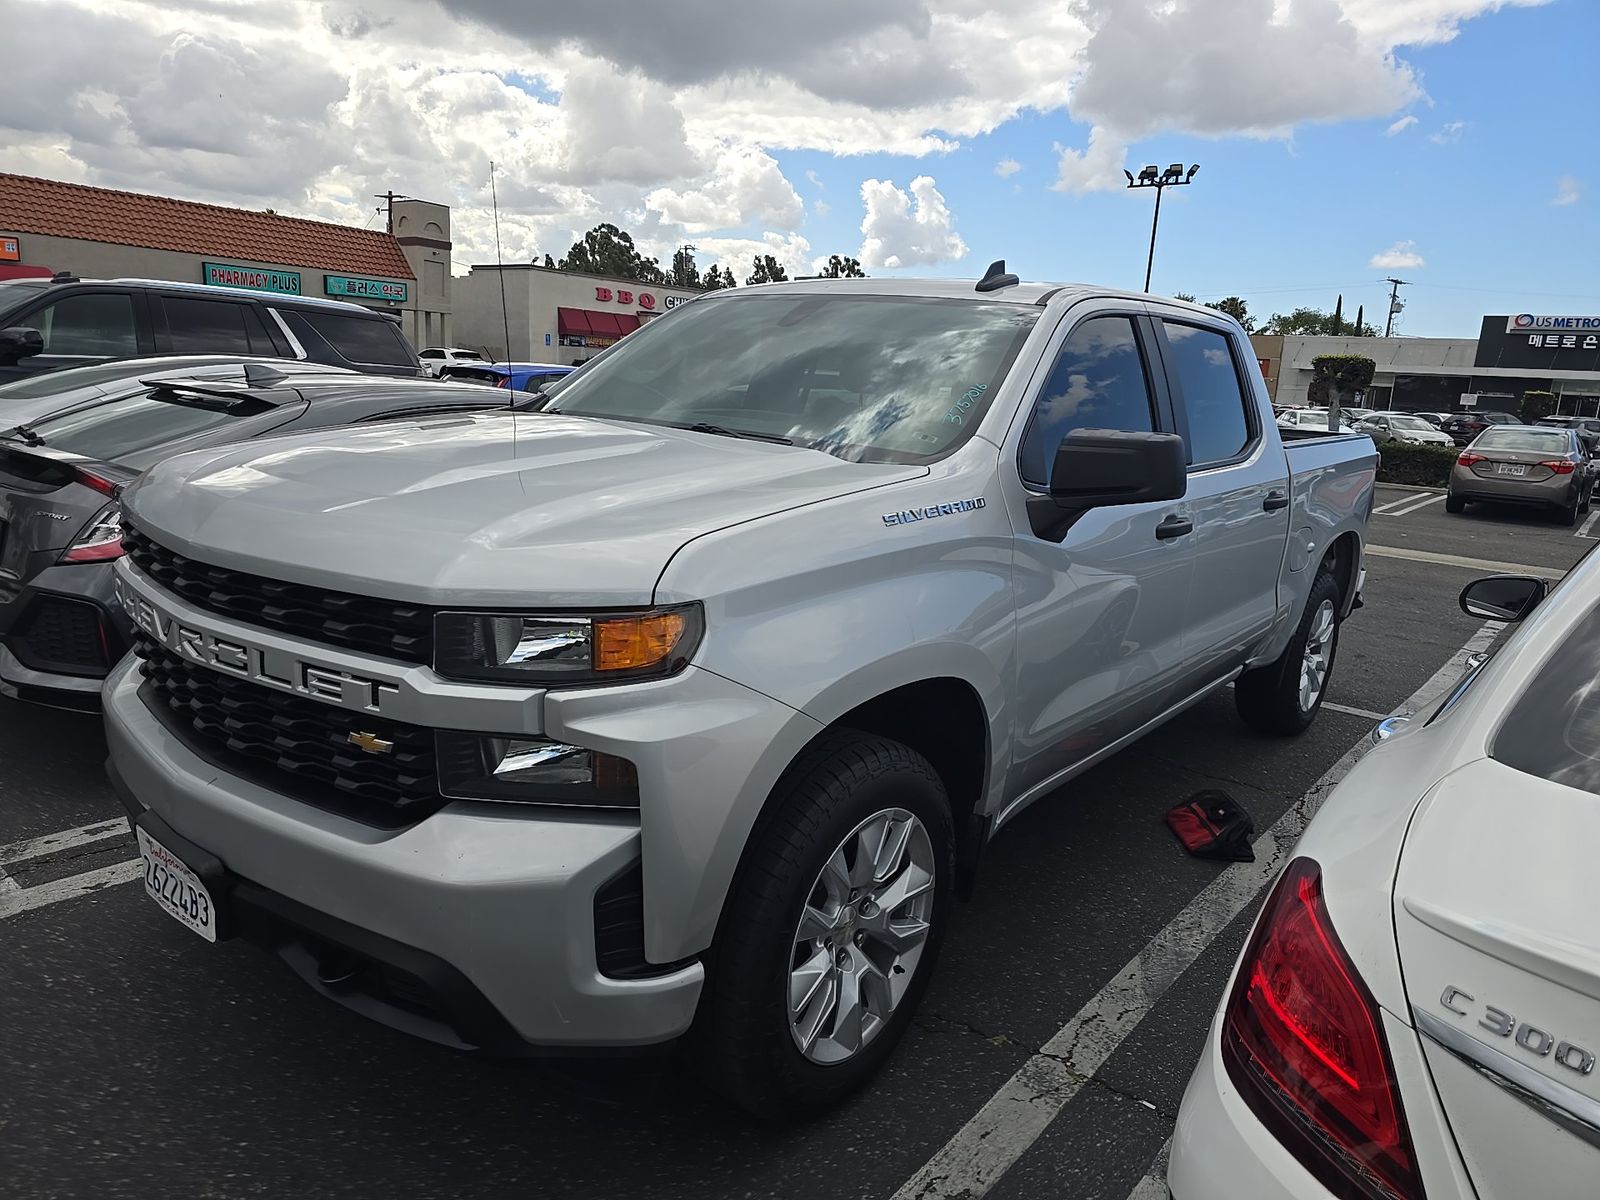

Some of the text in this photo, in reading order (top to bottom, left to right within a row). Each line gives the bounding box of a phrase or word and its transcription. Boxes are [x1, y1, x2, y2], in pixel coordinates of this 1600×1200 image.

[211, 268, 297, 291] PHARMACY PLUS
[346, 280, 403, 298] 플러스 약국
[596, 287, 656, 310] BBQ
[1536, 317, 1600, 328] US METRO
[1528, 334, 1599, 349] 메트로 은
[35, 511, 71, 521] SPORT
[882, 497, 986, 527] SILVERADO
[115, 577, 399, 712] CHEVROLET
[1440, 984, 1596, 1077] C 300
